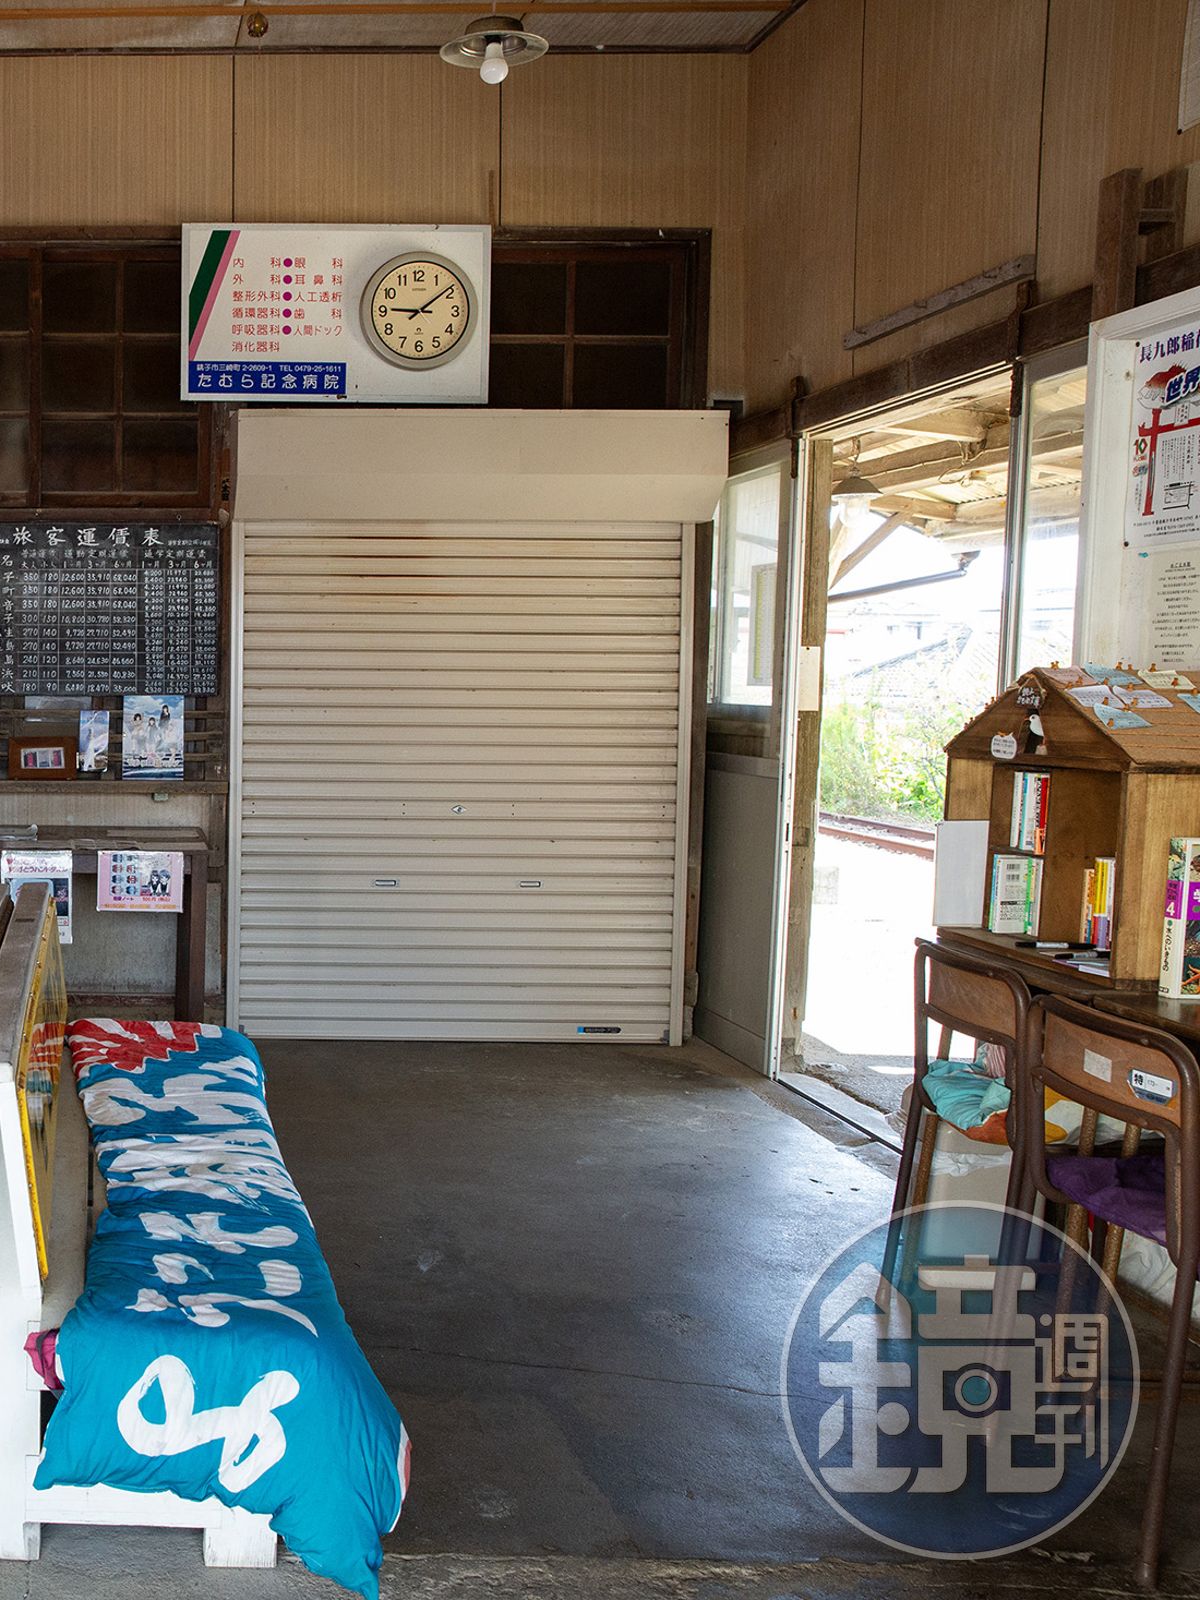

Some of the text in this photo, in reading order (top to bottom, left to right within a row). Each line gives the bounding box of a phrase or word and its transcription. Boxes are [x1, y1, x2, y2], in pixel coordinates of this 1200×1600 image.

[233, 274, 280, 284] 外科
[398, 274, 407, 286] 11
[413, 270, 424, 282] 12
[434, 274, 438, 286] 1
[232, 291, 280, 302] 整形外科
[294, 291, 342, 302] 人工透析
[384, 288, 396, 299] 10
[446, 287, 454, 299] 2
[232, 308, 280, 319] 循環器科
[378, 305, 387, 317] 9
[451, 305, 459, 317] 3
[232, 325, 280, 336] 呼吸器科
[294, 325, 342, 336] 人間ドック
[385, 323, 393, 335] 8
[445, 323, 453, 335] 4
[232, 341, 280, 352] 消化器科
[399, 336, 407, 348] 7
[415, 340, 423, 352] 6
[432, 337, 440, 348] 5
[198, 373, 339, 389] たむら記念病院
[13, 526, 164, 547] 旅客運賃表
[23, 586, 38, 594] 350
[44, 586, 58, 594] 180
[23, 600, 38, 608] 350
[44, 600, 58, 608] 180
[23, 628, 38, 636] 270
[44, 628, 58, 636] 140
[23, 642, 38, 650] 270
[44, 642, 58, 650] 140
[23, 656, 38, 664] 240
[44, 656, 58, 664] 120
[23, 683, 38, 691] 180
[47, 683, 57, 691] 90
[1166, 902, 1175, 916] 4
[1134, 1073, 1143, 1085] 特
